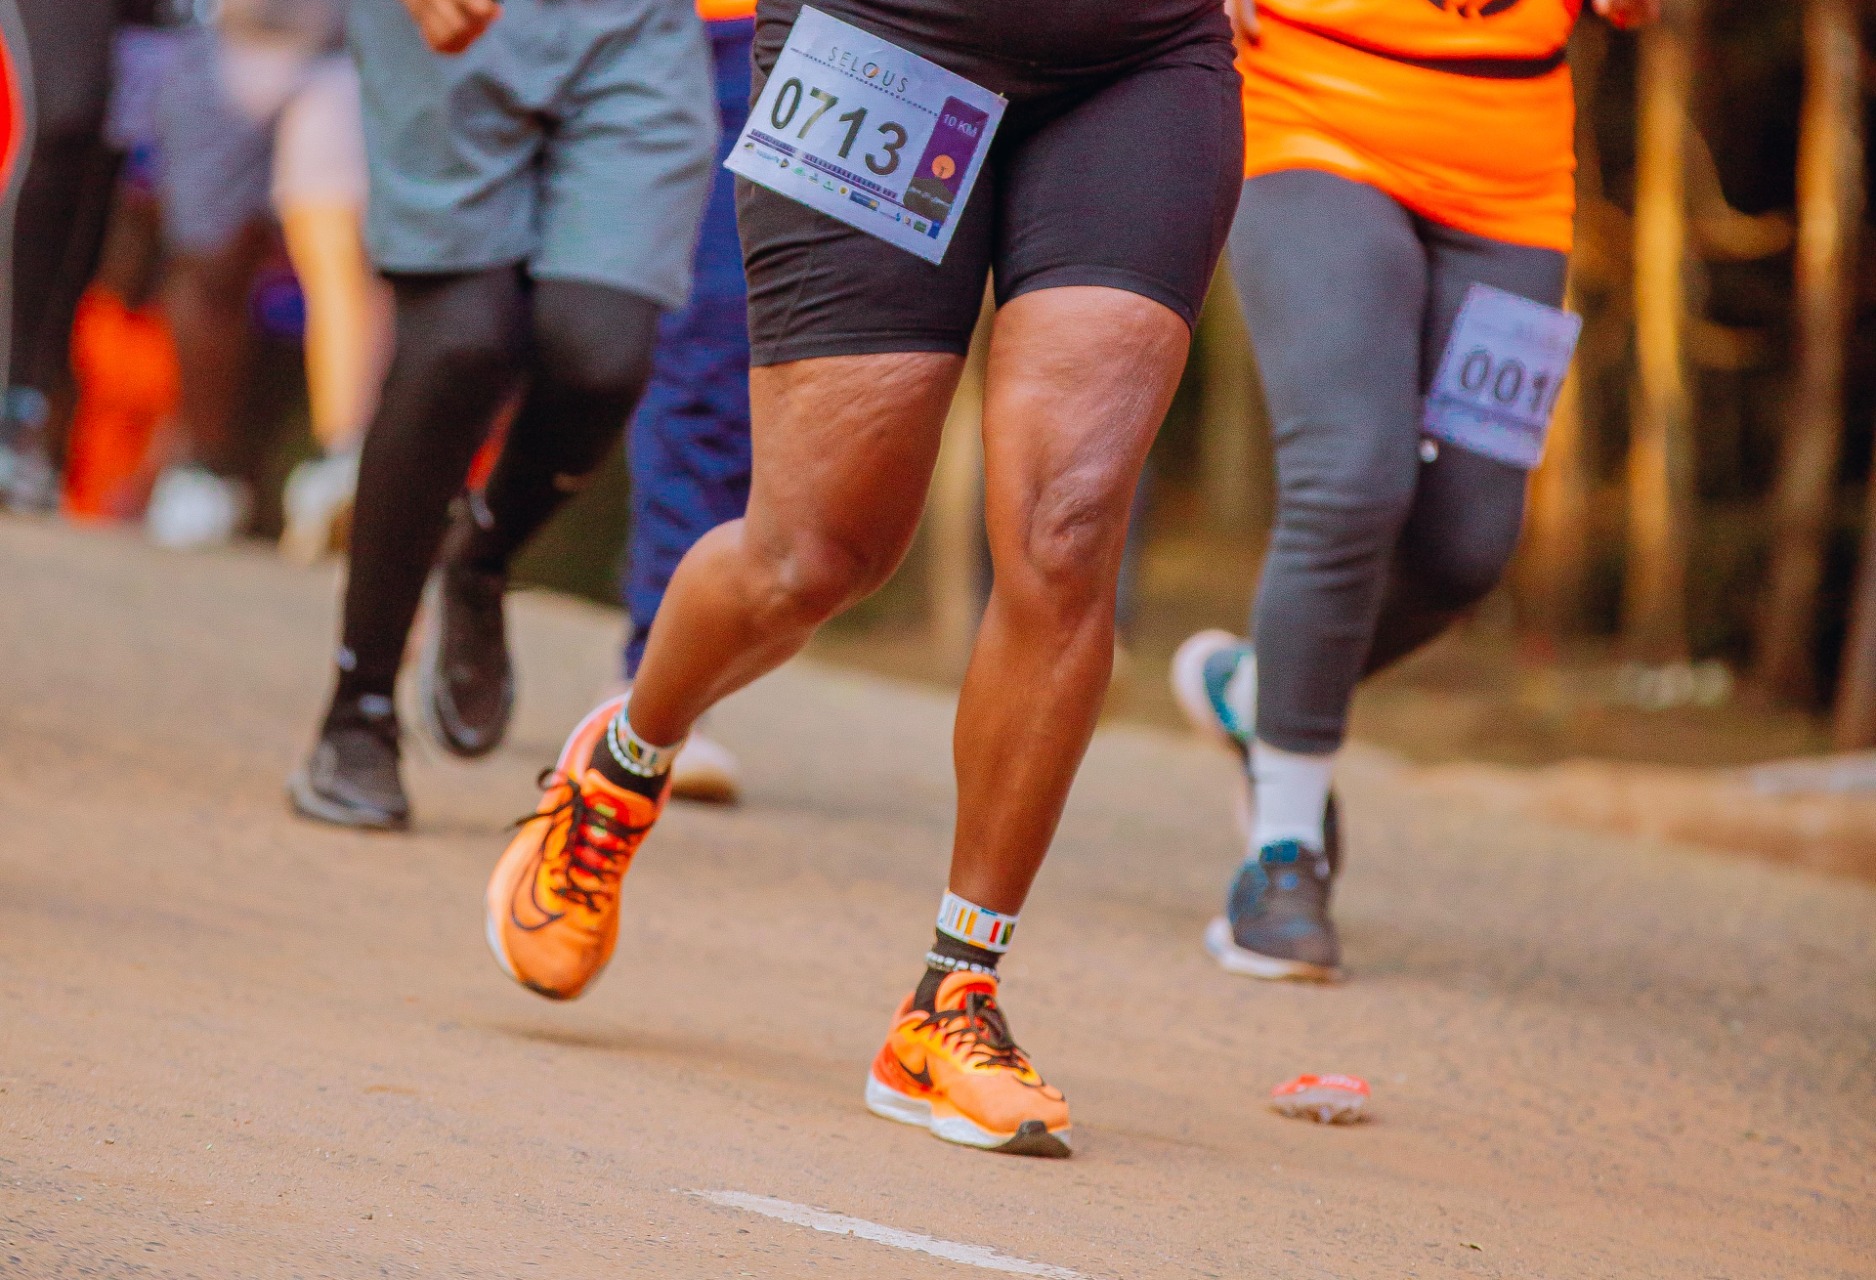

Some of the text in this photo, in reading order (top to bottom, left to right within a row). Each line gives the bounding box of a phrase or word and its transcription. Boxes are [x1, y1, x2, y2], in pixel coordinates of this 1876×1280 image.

[828, 46, 909, 93] SELOUS
[770, 76, 909, 176] 0713
[943, 113, 958, 128] 10
[1459, 348, 1563, 416] 001
